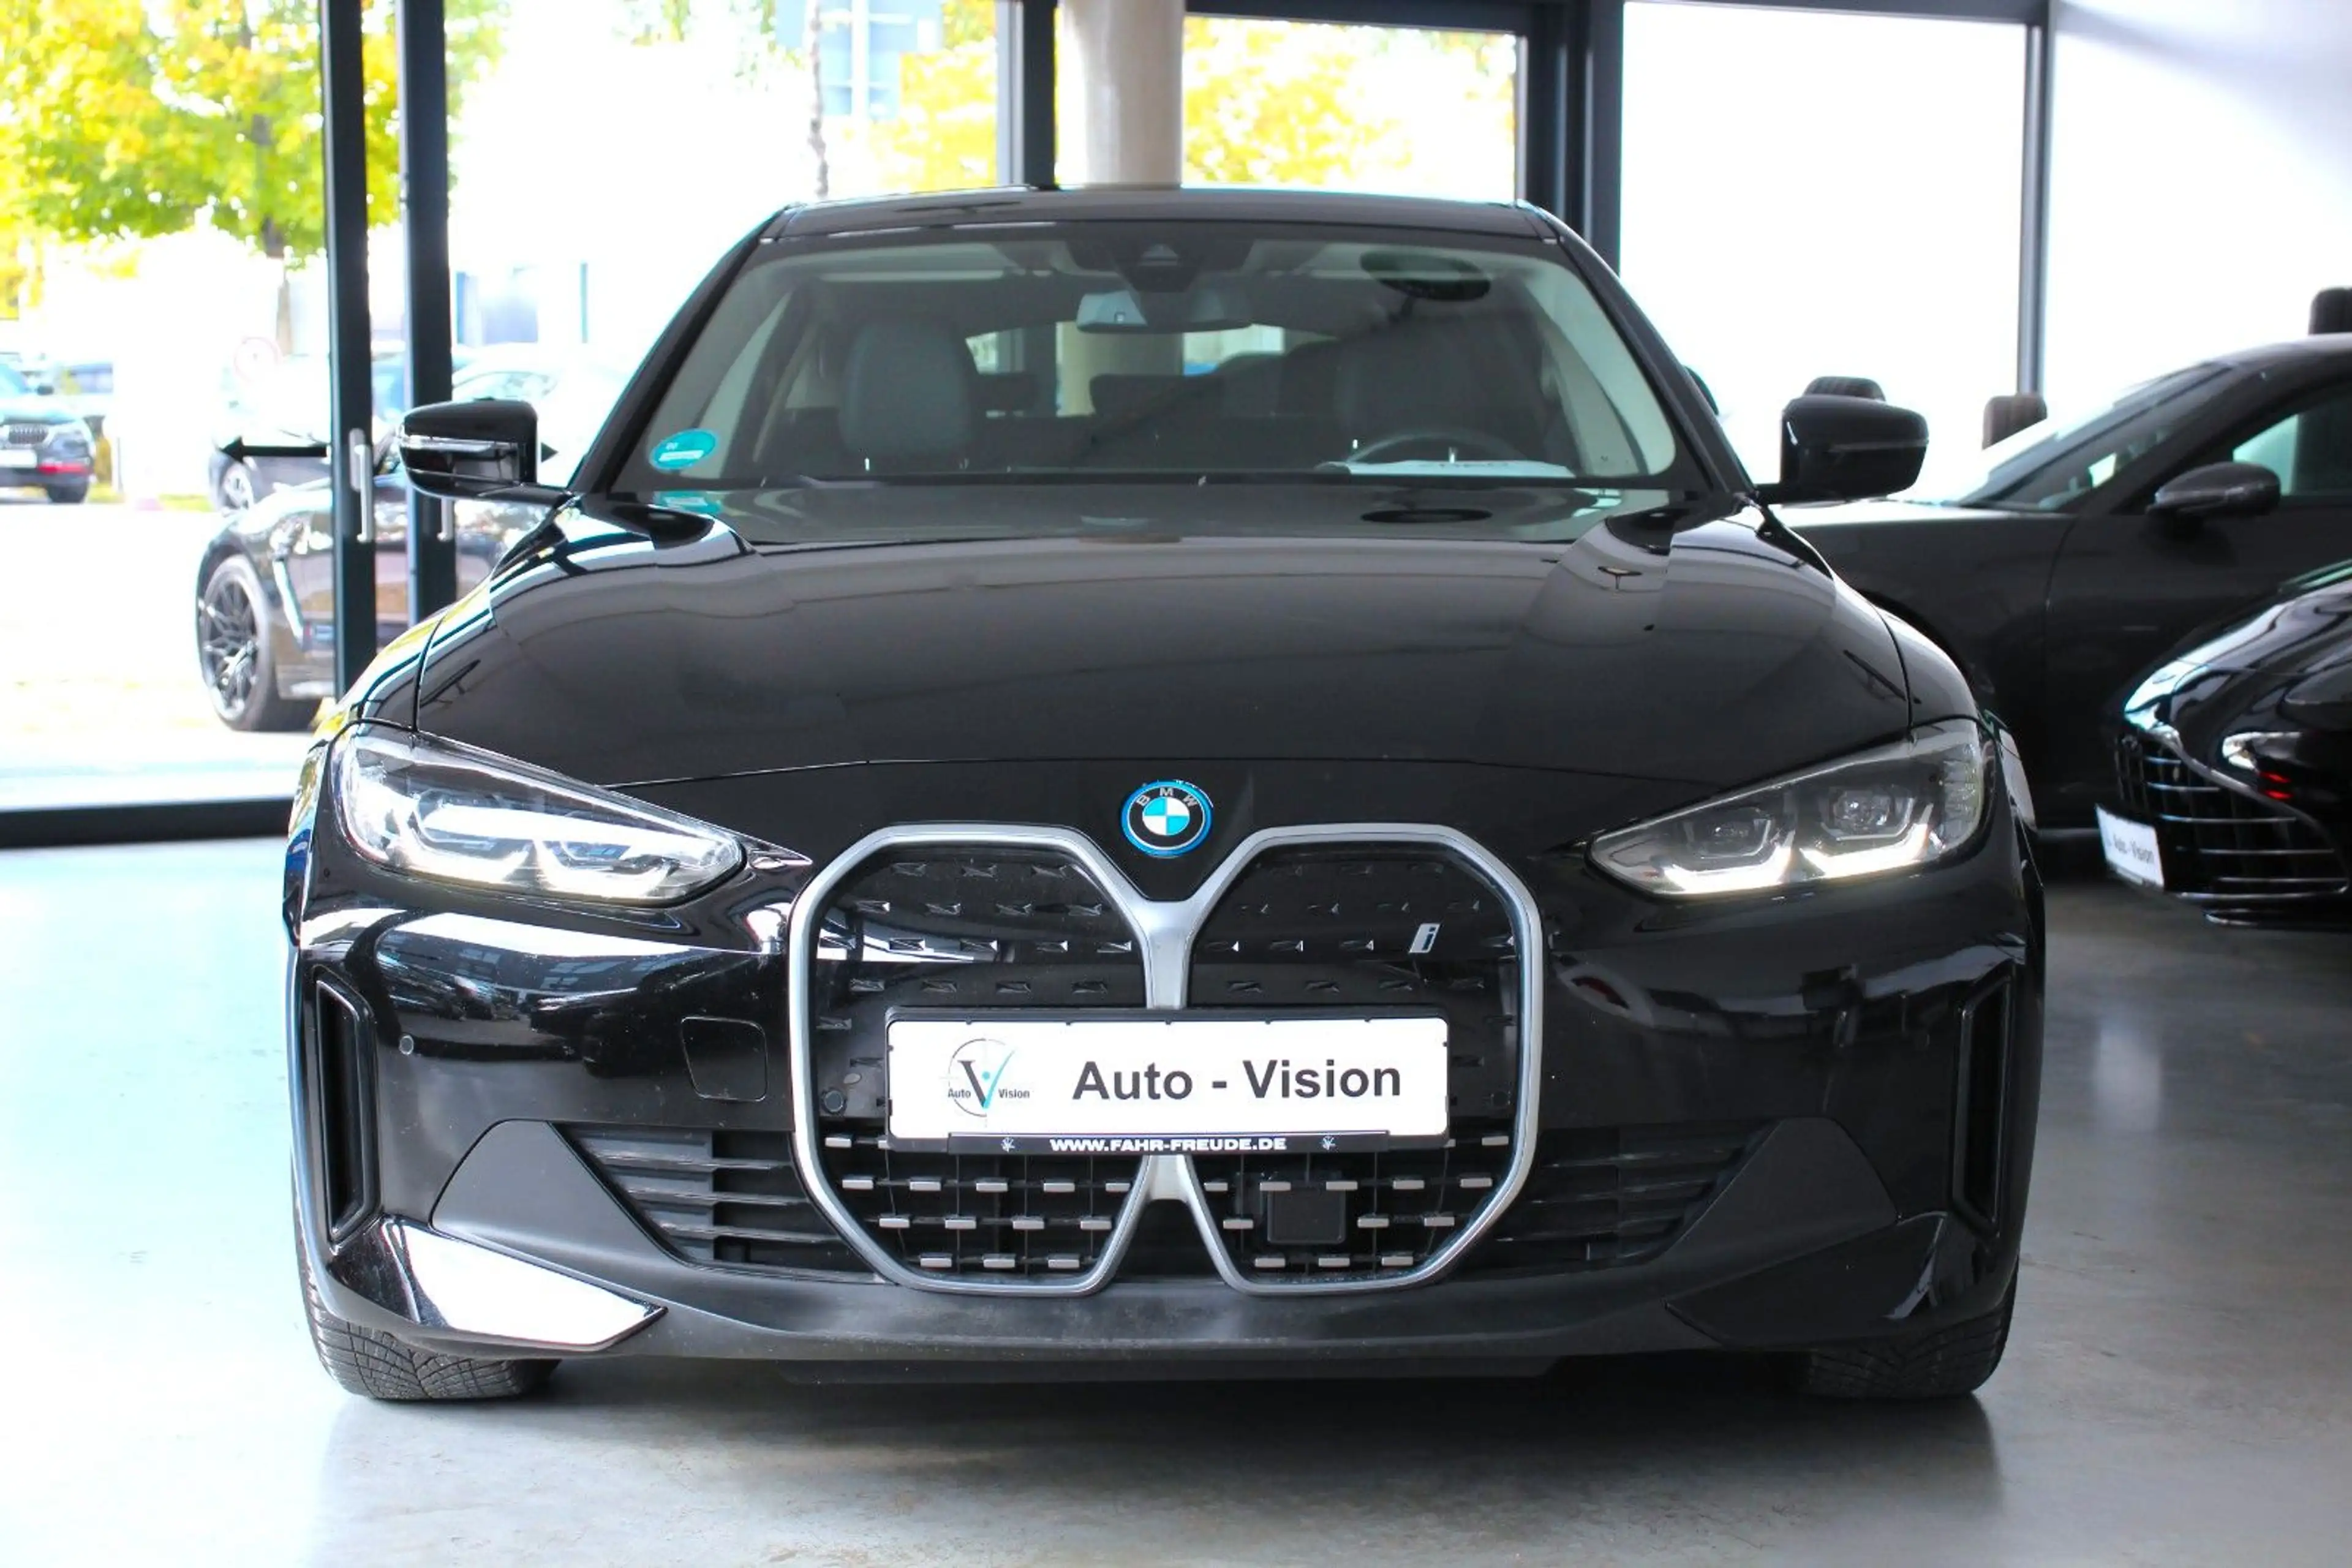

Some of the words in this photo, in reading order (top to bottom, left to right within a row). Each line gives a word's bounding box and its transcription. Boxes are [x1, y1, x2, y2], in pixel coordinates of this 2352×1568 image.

[1135, 787, 1199, 807] BMW
[1072, 1060, 1193, 1100] Auto
[1211, 1080, 1227, 1089] -
[1242, 1059, 1401, 1099] Vision
[948, 1088, 971, 1099] Auto
[998, 1088, 1030, 1099] Vision
[1049, 1137, 1287, 1152] WWW.FAHR-FREUDE.DE
